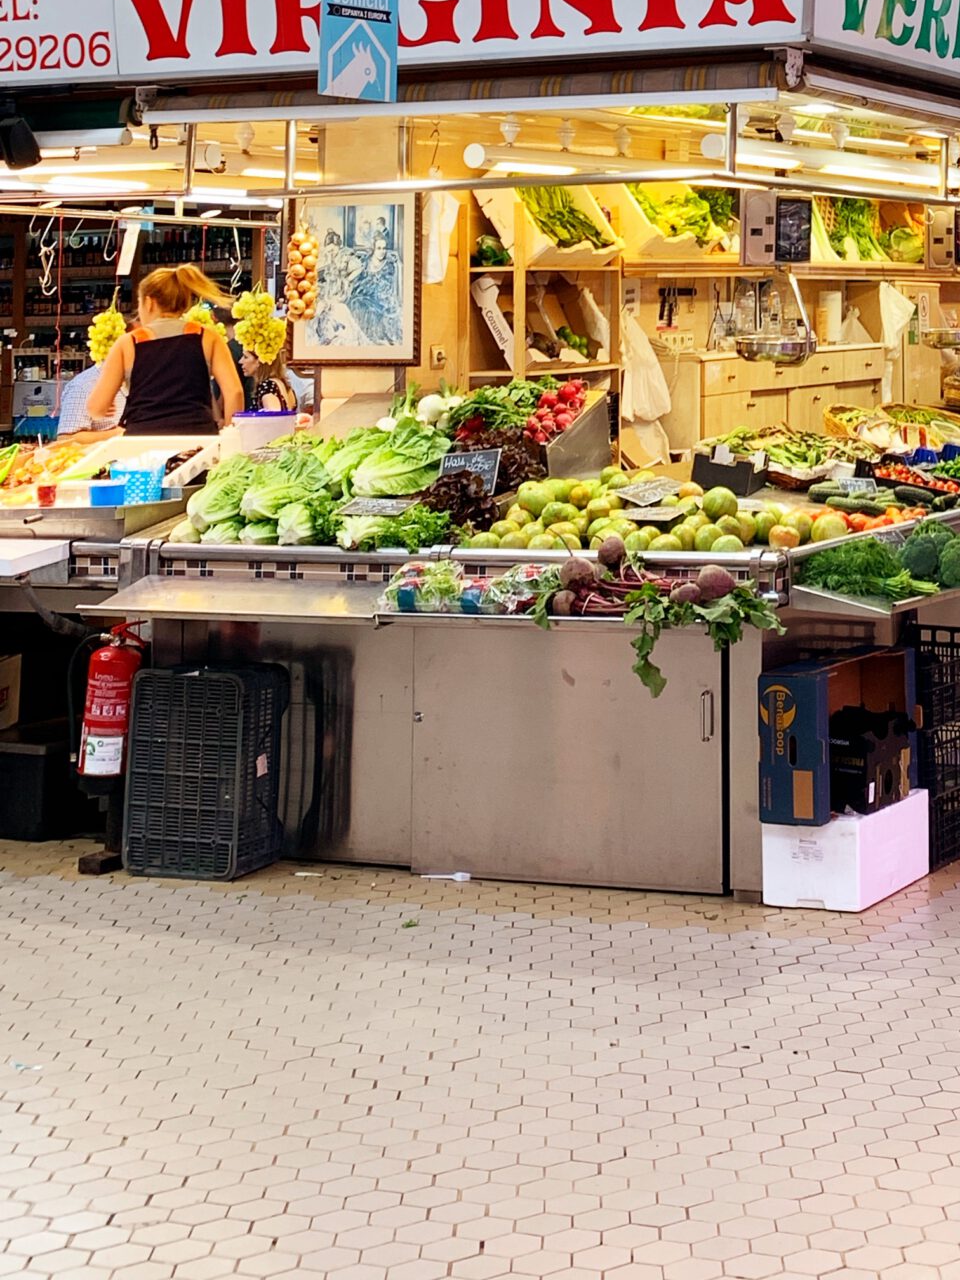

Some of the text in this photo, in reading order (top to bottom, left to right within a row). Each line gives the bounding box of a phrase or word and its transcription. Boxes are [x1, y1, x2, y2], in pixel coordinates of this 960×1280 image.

[341, 7, 364, 18] ESPANYA
[0, 31, 111, 72] 29206
[485, 310, 509, 345] Cozumel
